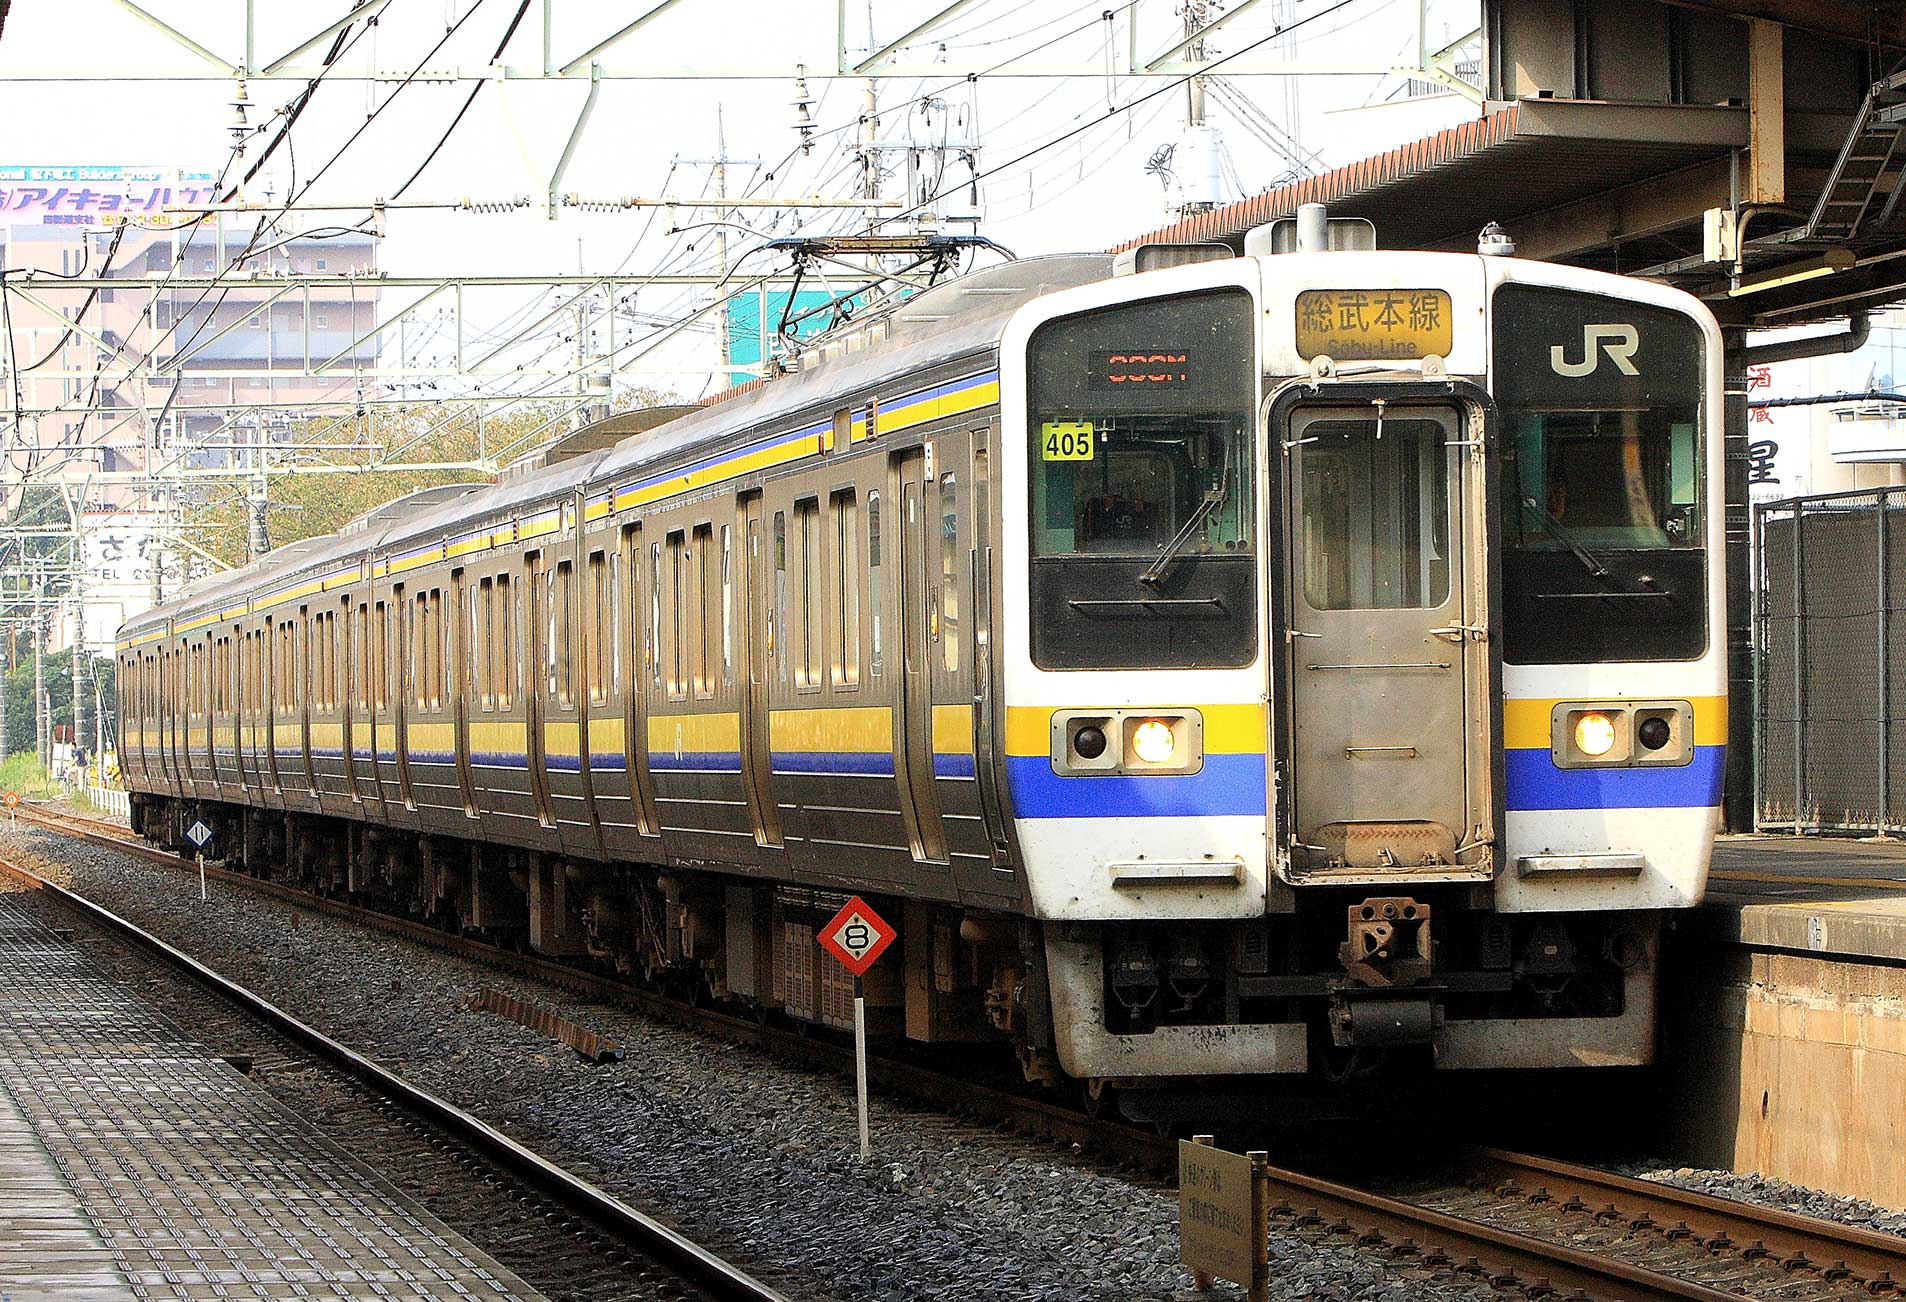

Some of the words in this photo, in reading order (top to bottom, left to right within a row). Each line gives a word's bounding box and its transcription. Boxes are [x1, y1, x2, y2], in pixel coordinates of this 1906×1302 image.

[1303, 293, 1441, 333] 総武本線
[1551, 323, 1641, 378] JR
[1046, 432, 1090, 457] 405
[844, 924, 870, 950] 8
